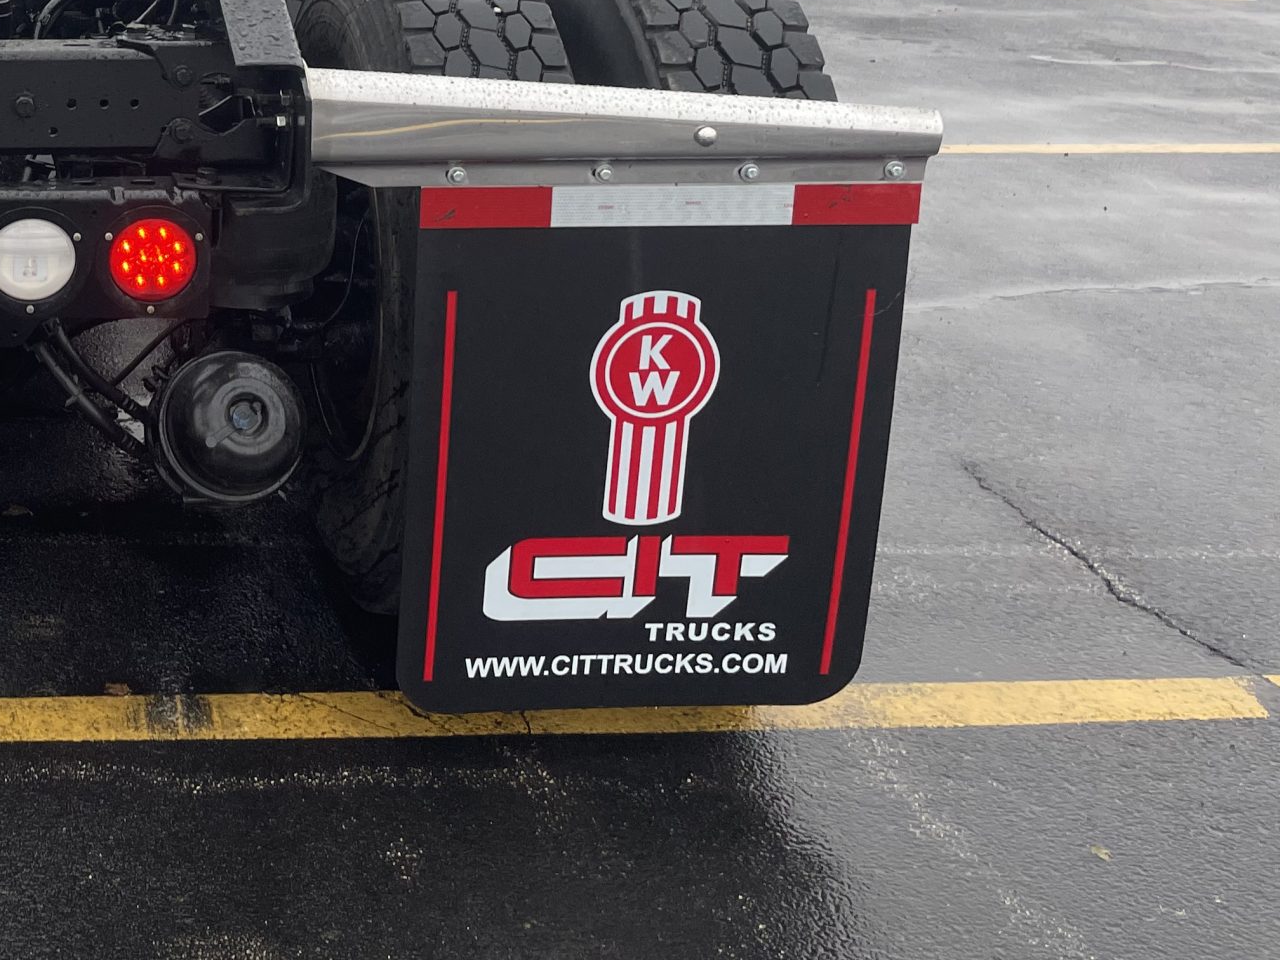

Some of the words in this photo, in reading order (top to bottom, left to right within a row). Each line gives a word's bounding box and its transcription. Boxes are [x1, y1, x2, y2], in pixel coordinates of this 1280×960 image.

[638, 334, 672, 369] K
[628, 370, 681, 407] W
[483, 534, 790, 622] CIT
[644, 622, 777, 643] TRUCKS
[465, 652, 788, 679] WWW.CITTRUCKS.COM
